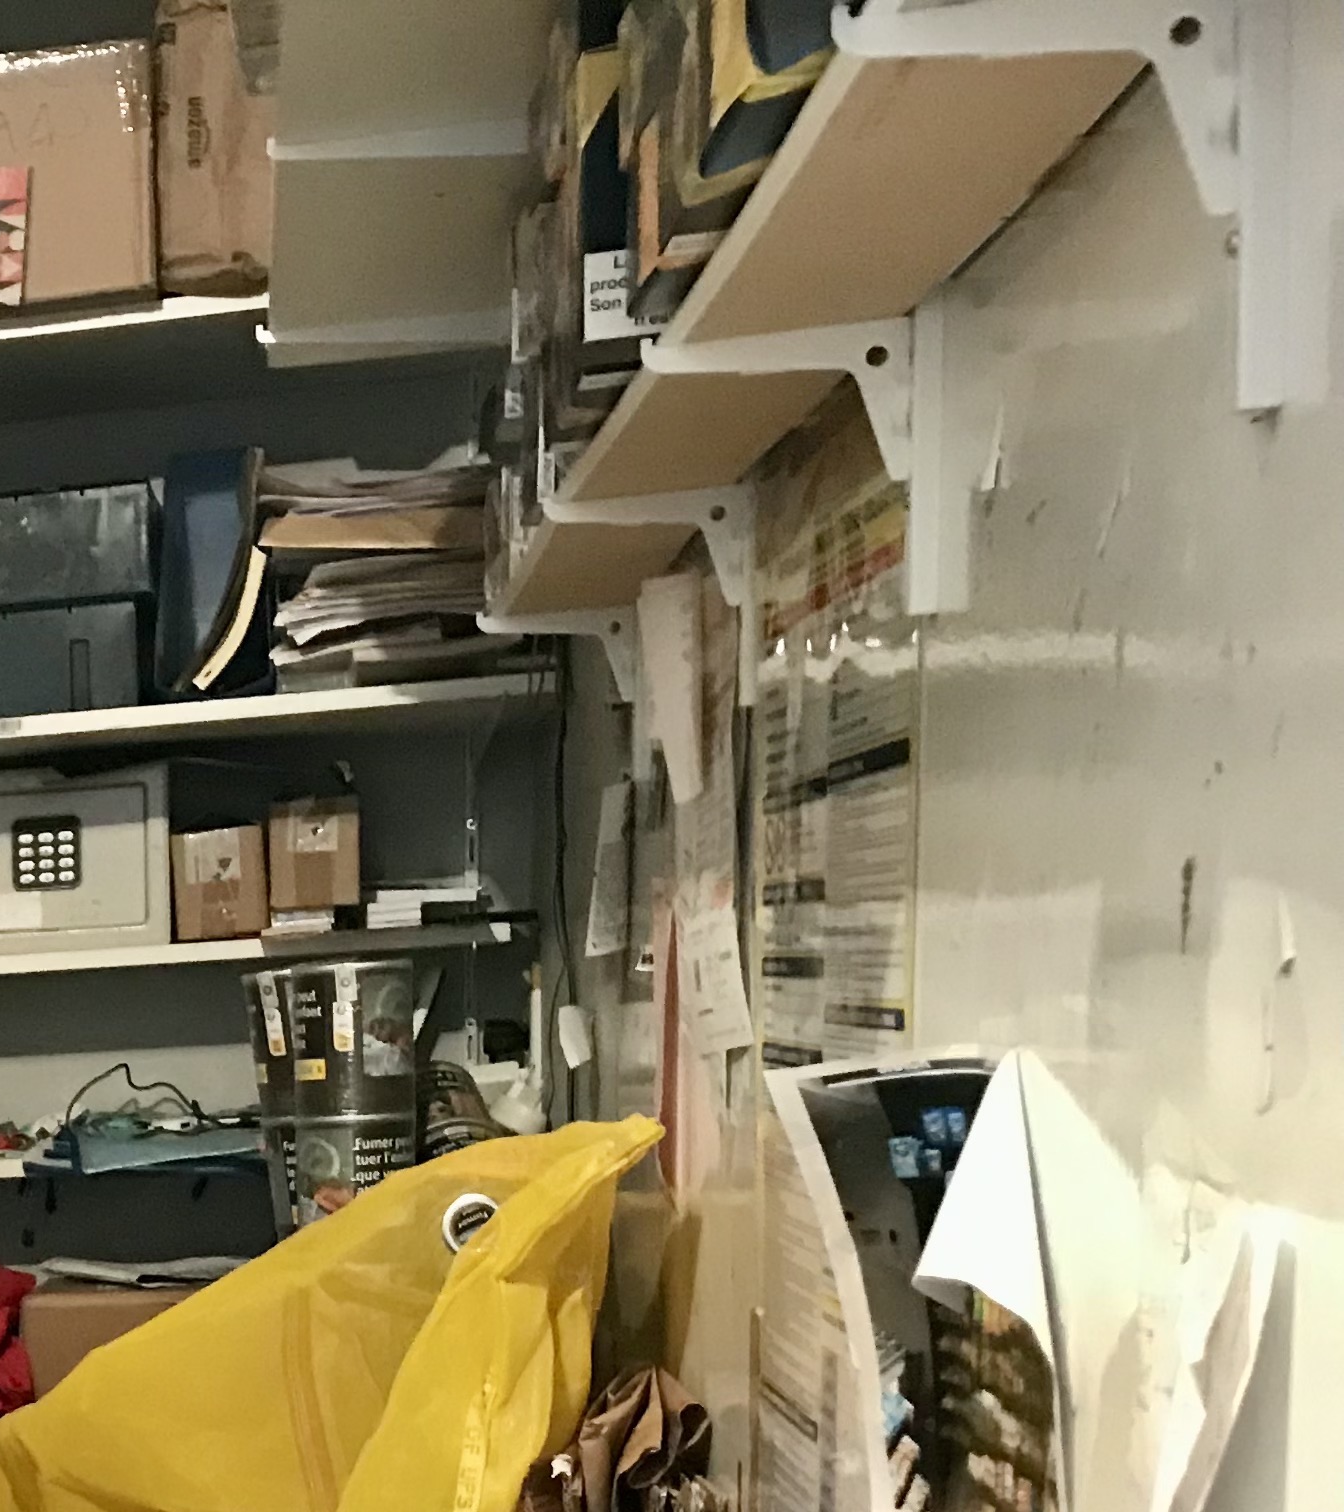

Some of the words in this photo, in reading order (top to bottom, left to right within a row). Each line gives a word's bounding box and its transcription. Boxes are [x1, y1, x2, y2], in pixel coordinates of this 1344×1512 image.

[187, 97, 204, 169] amazon
[355, 1137, 394, 1151] Fumer
[355, 1152, 382, 1165] tuer
[355, 1169, 381, 1183] que
